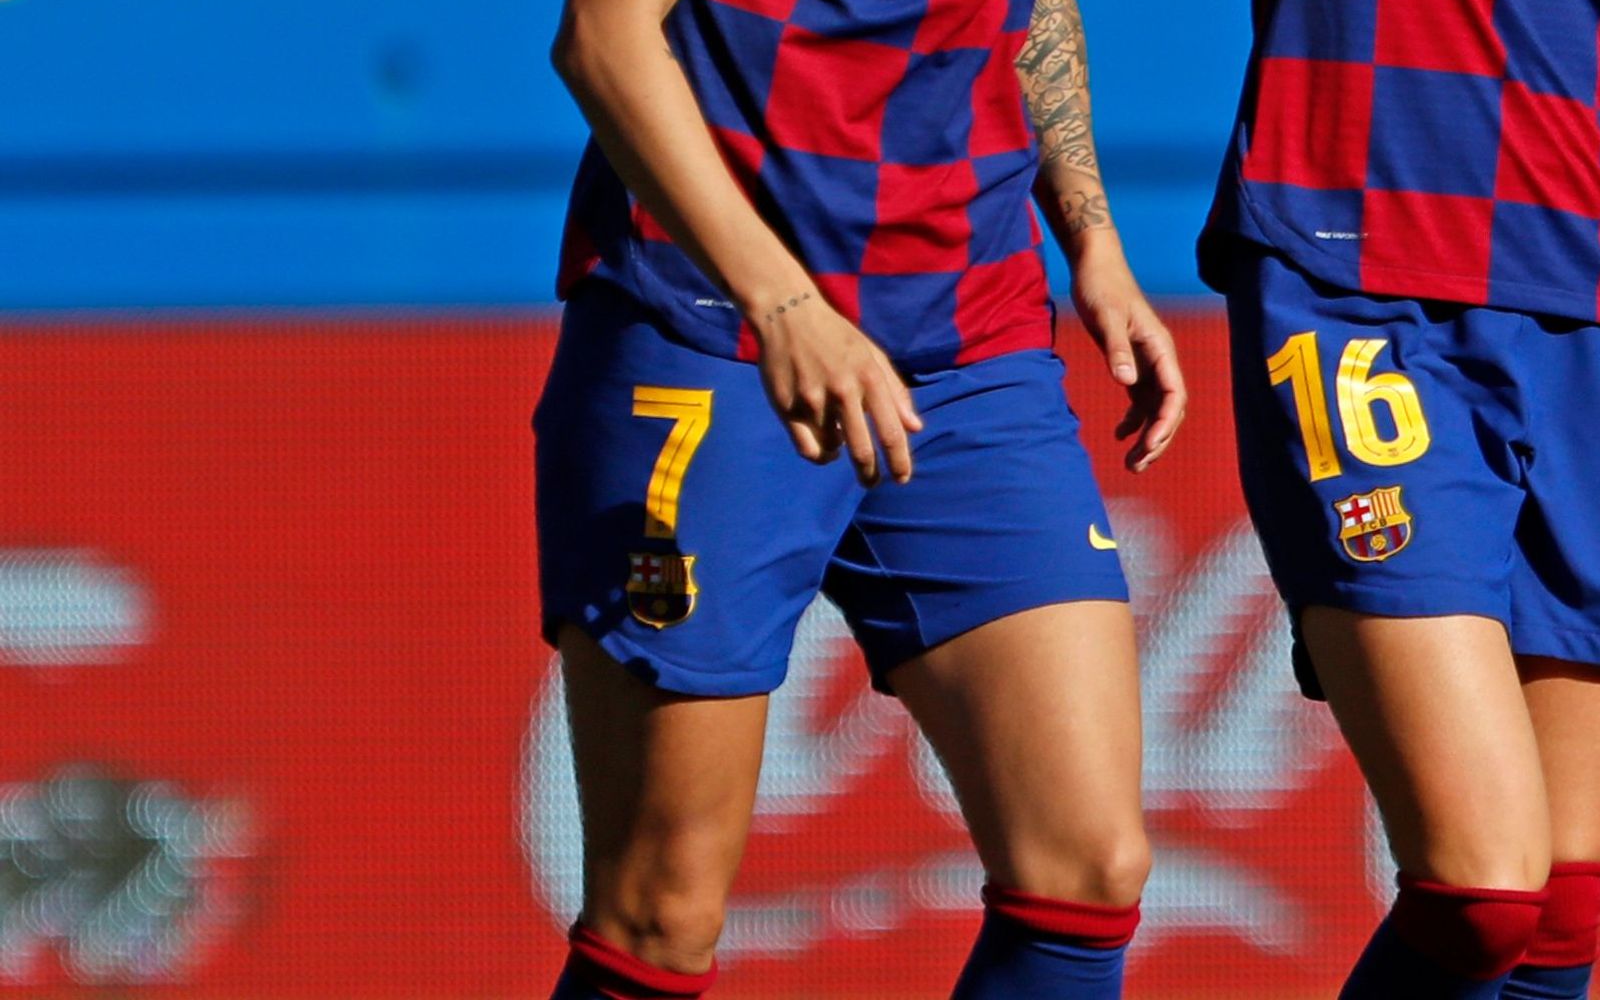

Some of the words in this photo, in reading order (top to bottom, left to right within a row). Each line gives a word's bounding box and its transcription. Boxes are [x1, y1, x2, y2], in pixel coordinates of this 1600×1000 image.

[632, 385, 713, 539] 7
[1265, 330, 1431, 482] 16
[1360, 518, 1387, 532] FCB
